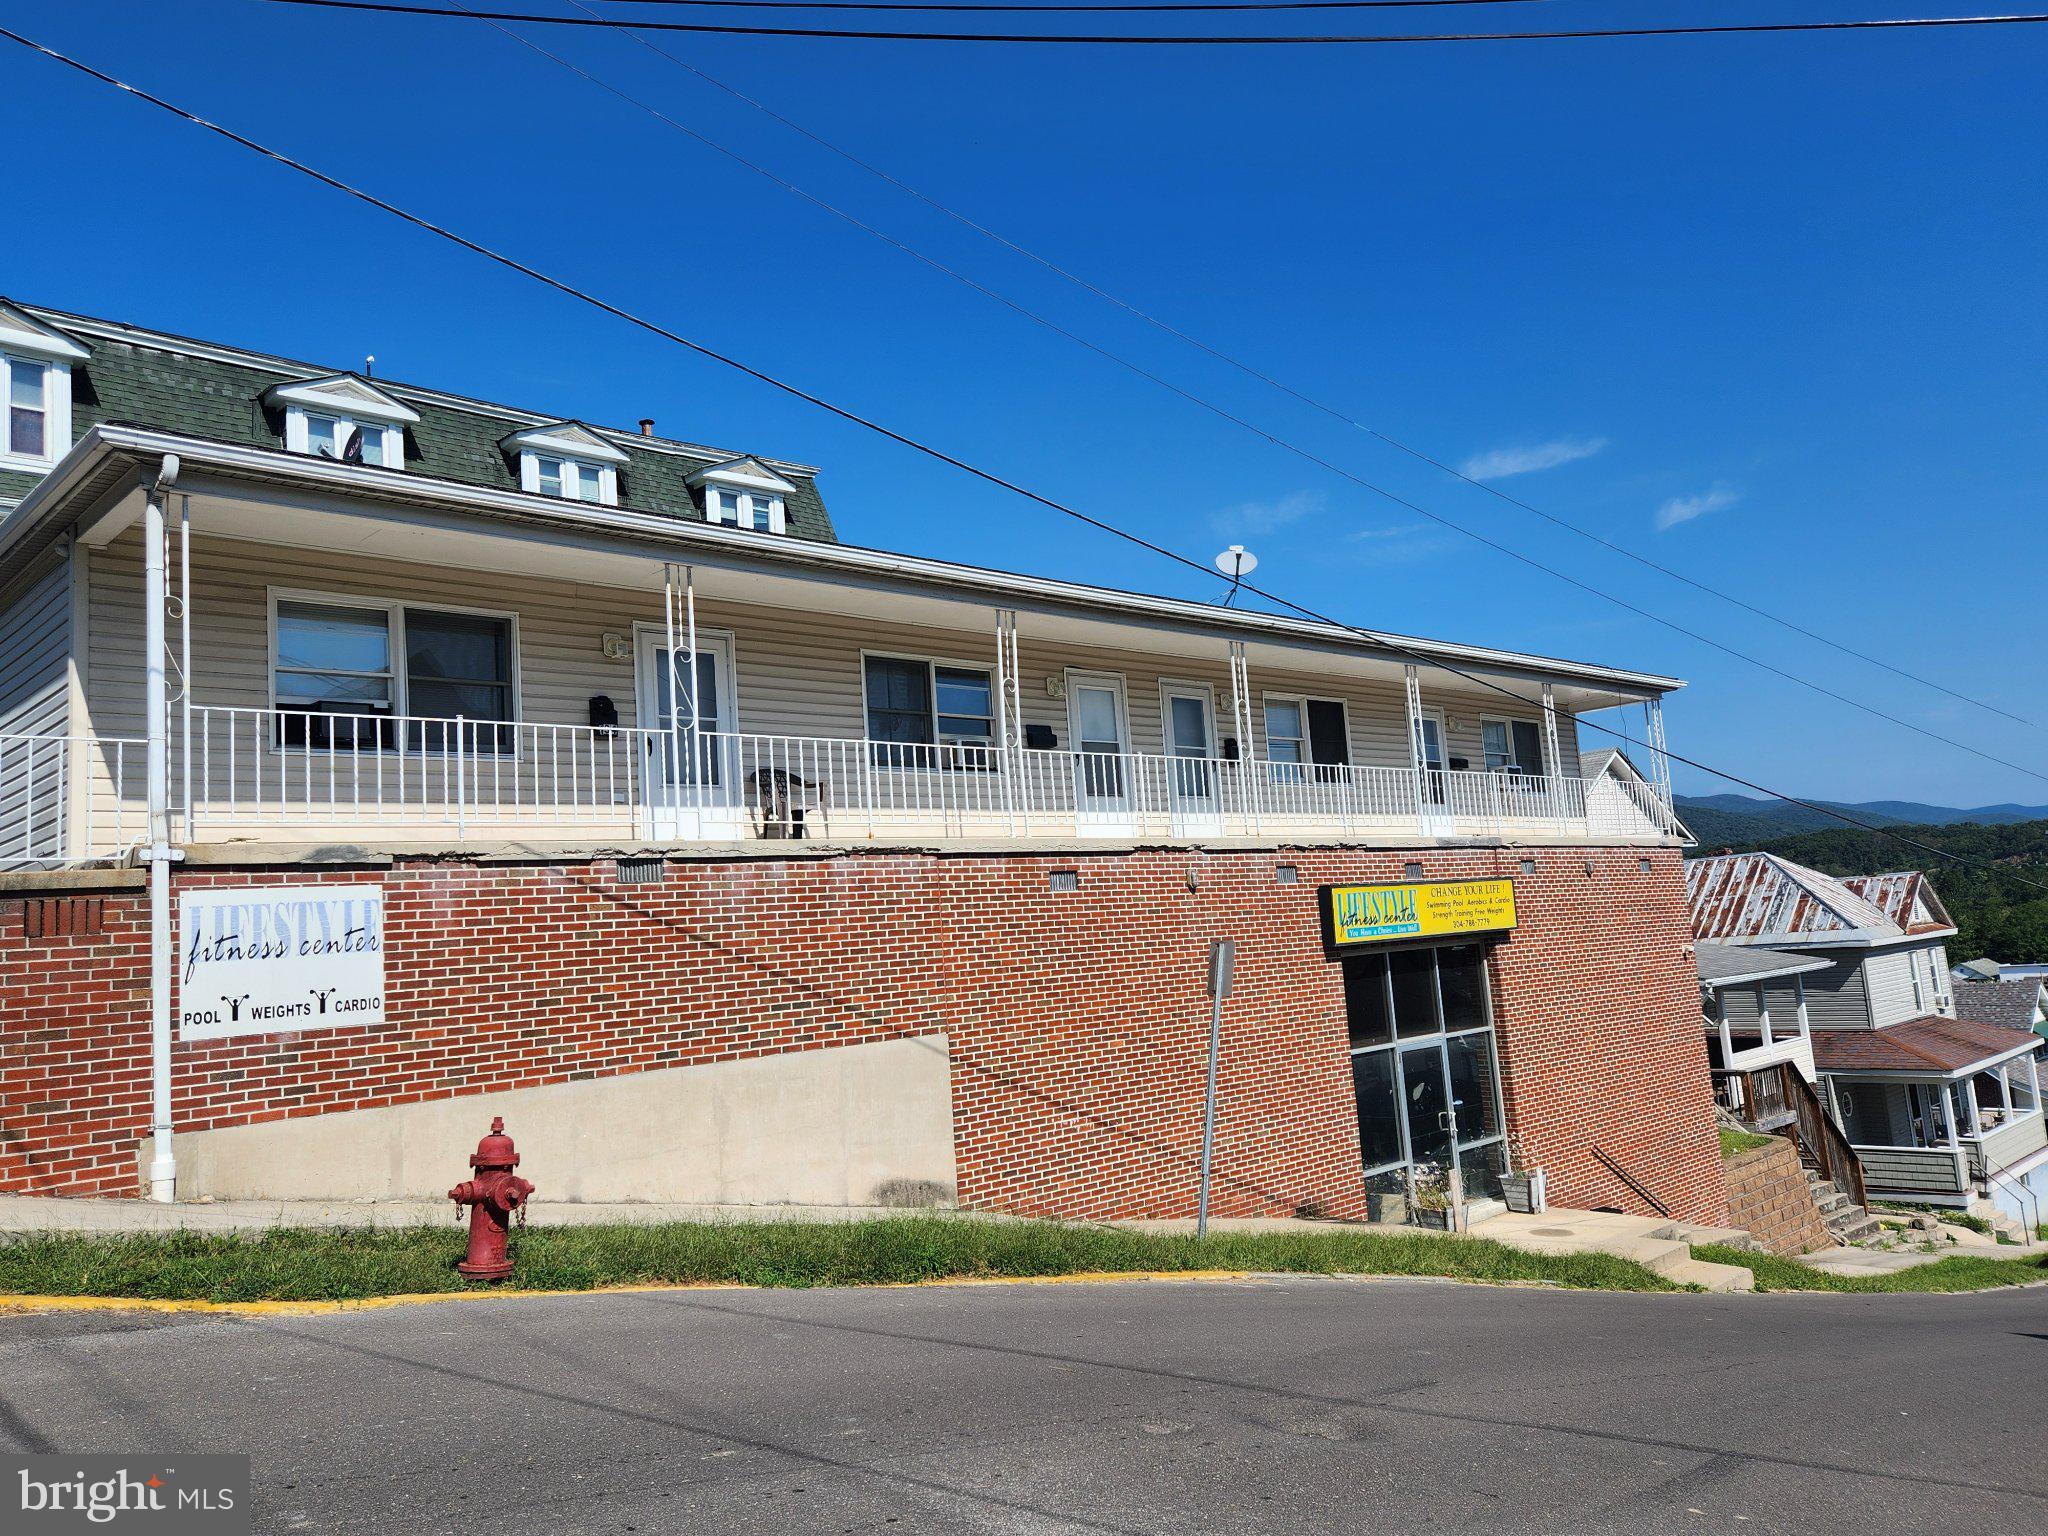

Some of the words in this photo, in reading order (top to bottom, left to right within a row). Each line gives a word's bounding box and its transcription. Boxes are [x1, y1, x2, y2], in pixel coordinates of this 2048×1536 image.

[1426, 900, 1451, 909] Swimming
[1452, 899, 1464, 907] Pool
[1467, 897, 1488, 906] Aerobics
[1495, 896, 1510, 904] Cardio
[1431, 886, 1462, 898] CHANGE
[1464, 885, 1484, 896] YOUR
[1485, 884, 1500, 895] LIFE
[1337, 889, 1417, 926] LIFESTYLE
[1340, 912, 1378, 937] fitness
[1384, 906, 1418, 924] center
[1432, 910, 1454, 919] Strength
[1454, 909, 1474, 917] Training
[1487, 906, 1505, 916] Weights
[188, 898, 380, 963] LIFESTYLE
[1349, 929, 1359, 937] You
[184, 928, 288, 986] fitness
[299, 926, 380, 956] center
[184, 1011, 221, 1026] POOL
[251, 1002, 311, 1020] WEIGHTS
[335, 997, 380, 1013] CARDIO
